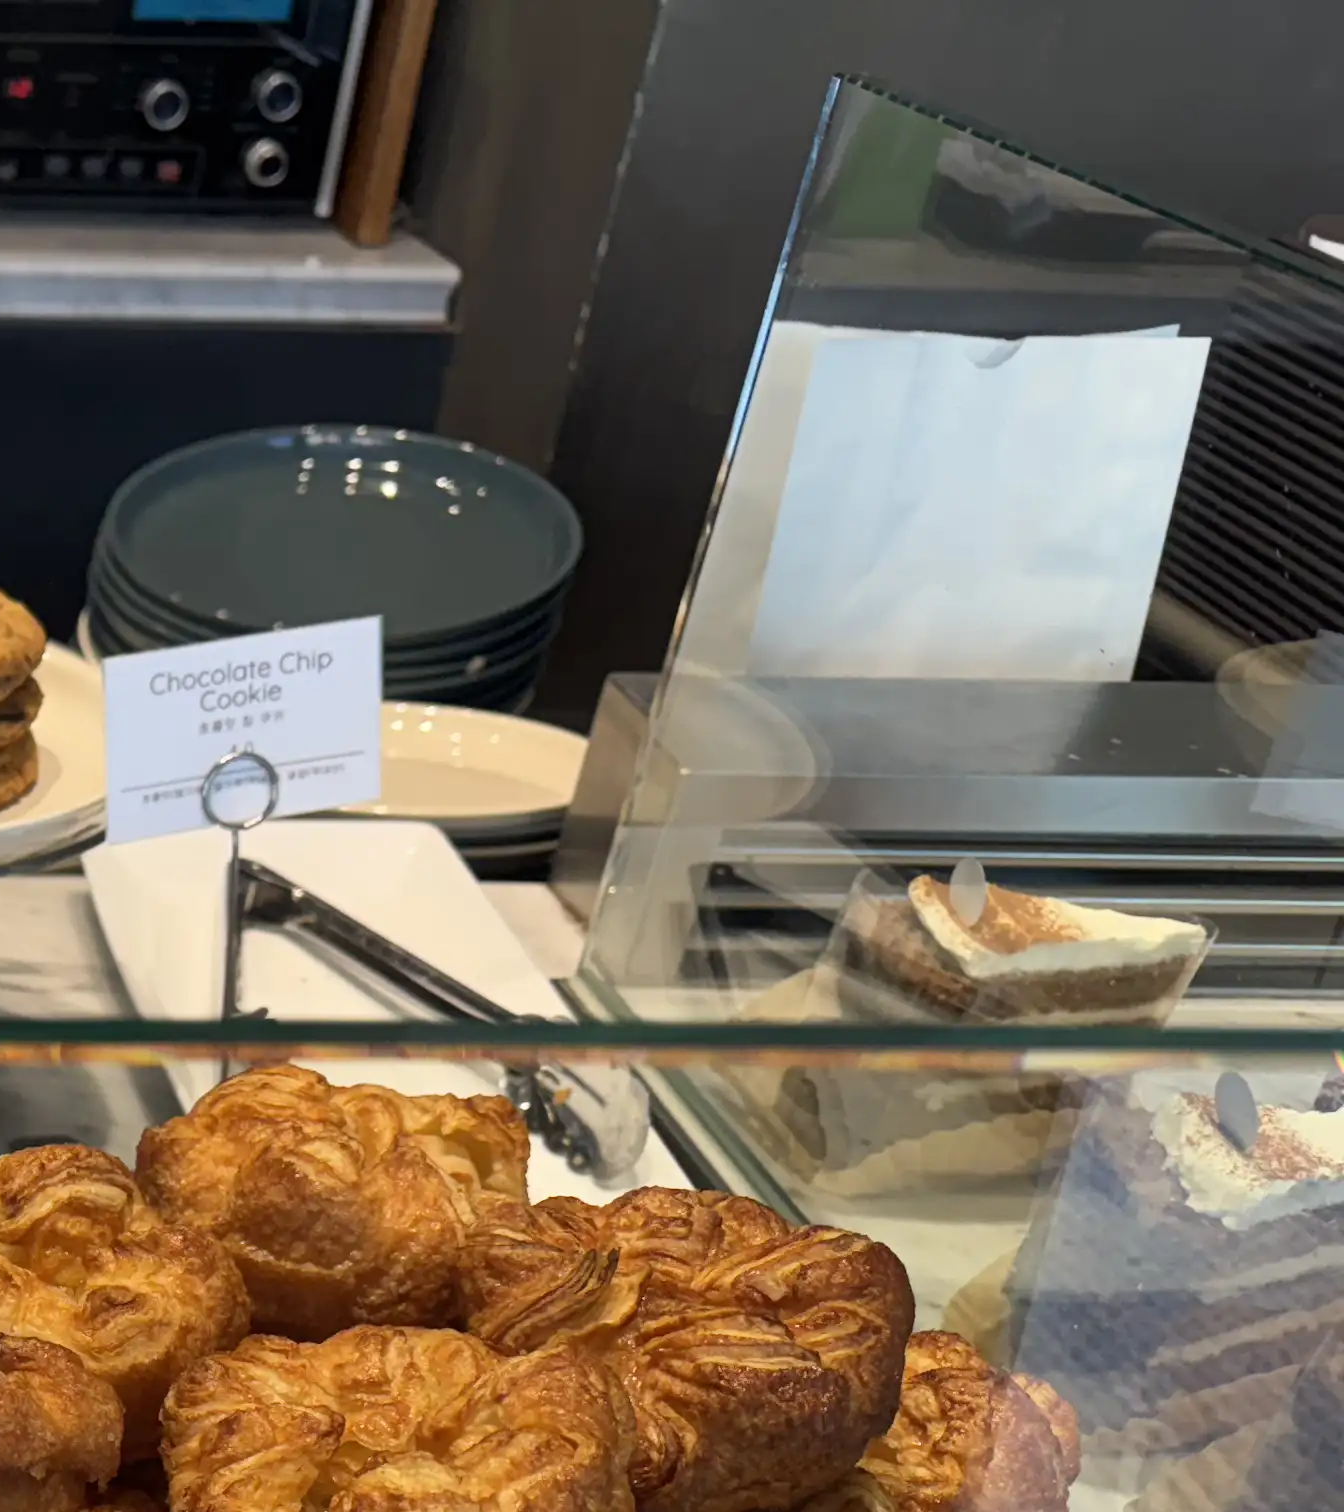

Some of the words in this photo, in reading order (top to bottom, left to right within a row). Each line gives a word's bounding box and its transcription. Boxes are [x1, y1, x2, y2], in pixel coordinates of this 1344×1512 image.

[149, 659, 272, 697] Chocolate
[279, 650, 334, 676] Chip
[199, 683, 283, 713] Cookie
